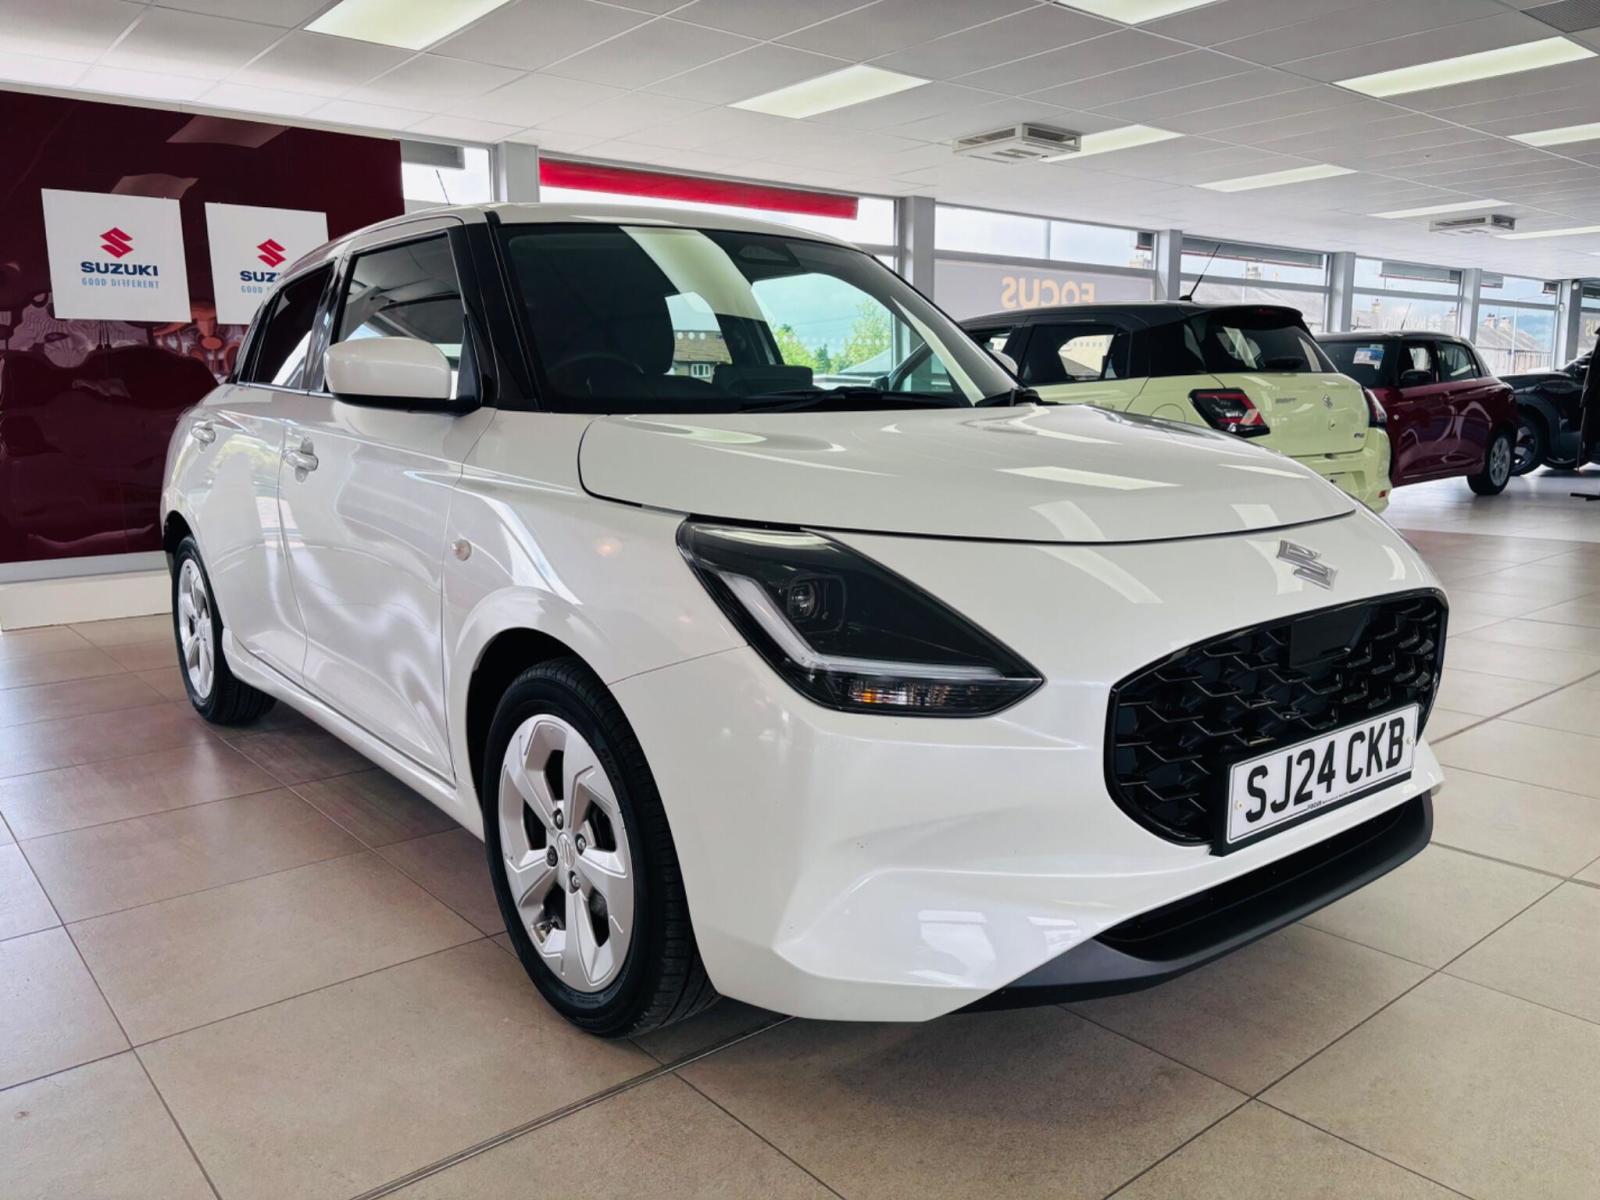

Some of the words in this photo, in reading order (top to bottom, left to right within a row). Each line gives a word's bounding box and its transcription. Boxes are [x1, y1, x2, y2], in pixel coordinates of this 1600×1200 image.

[80, 261, 159, 276] SUZUKI
[240, 270, 281, 282] SUZ
[81, 278, 107, 286] GOOD
[111, 279, 159, 288] DIFFERENT
[1245, 741, 1336, 823] SJ24
[1346, 716, 1405, 784] CKB
